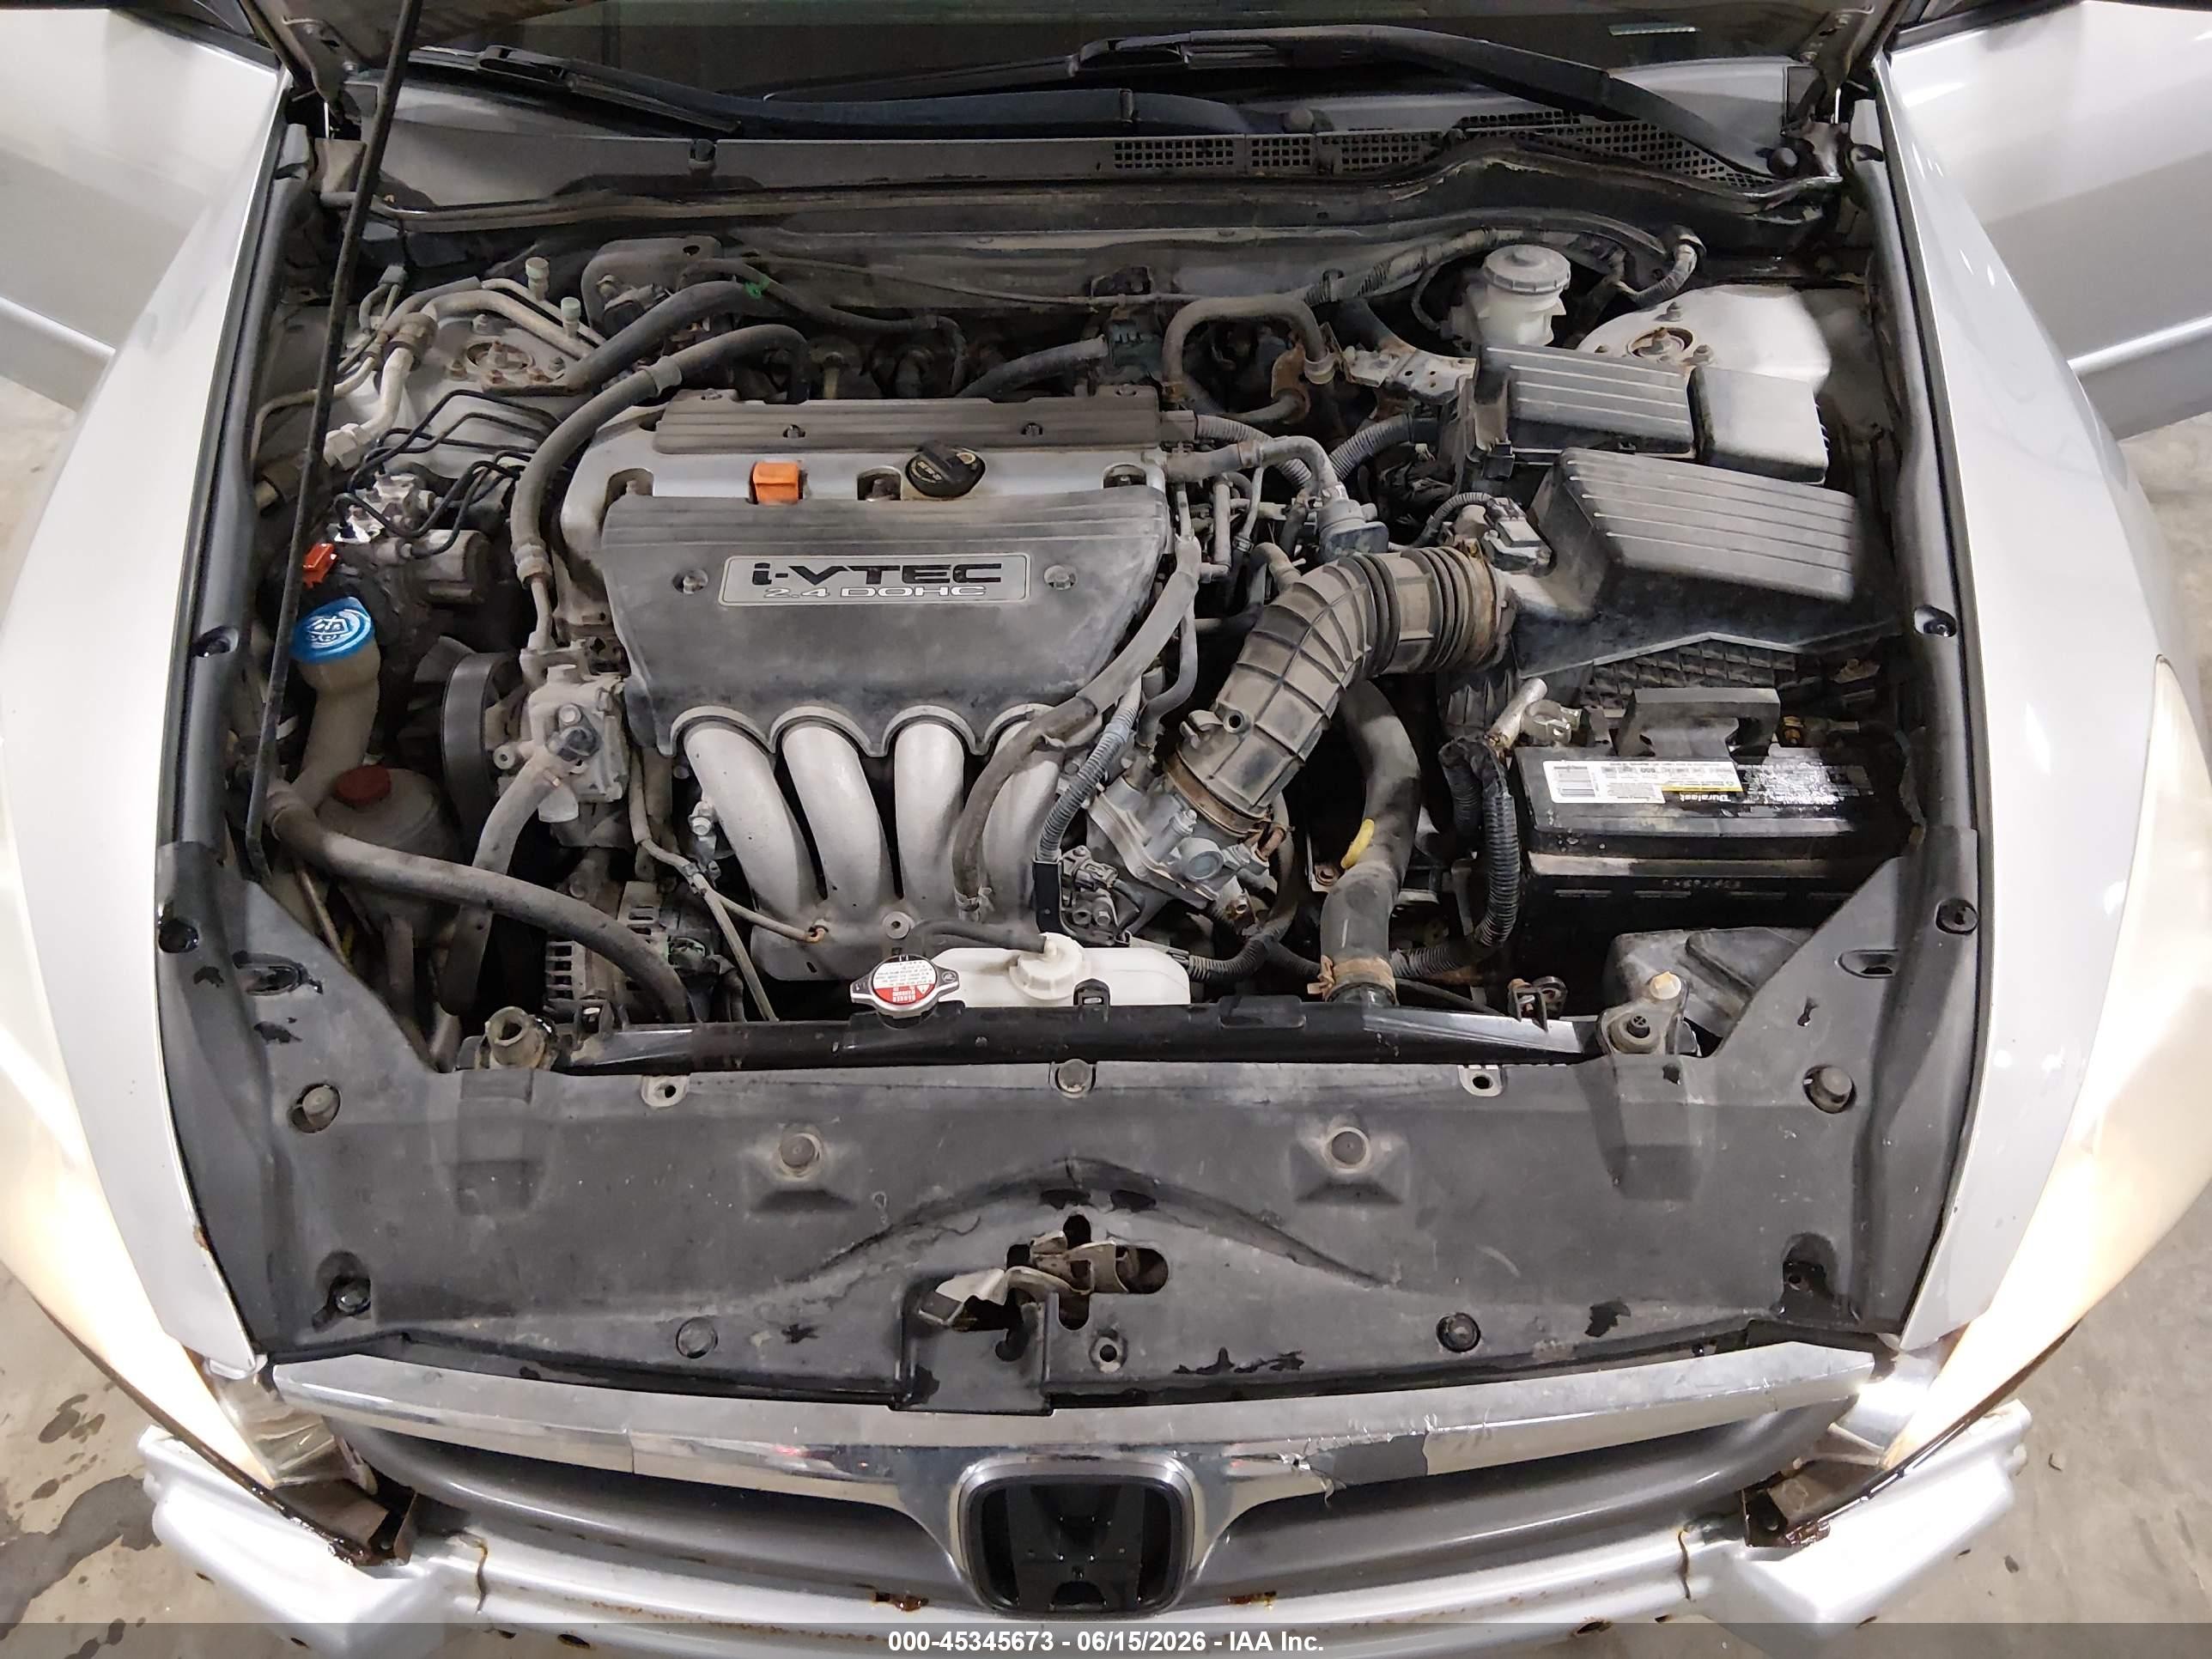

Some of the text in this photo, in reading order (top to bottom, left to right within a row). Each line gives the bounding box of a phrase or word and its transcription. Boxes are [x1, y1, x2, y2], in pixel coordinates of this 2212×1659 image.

[752, 562, 1002, 586] i-VTEC
[764, 586, 987, 599] 2.4 DOHC
[1680, 793, 1731, 803] Duralast
